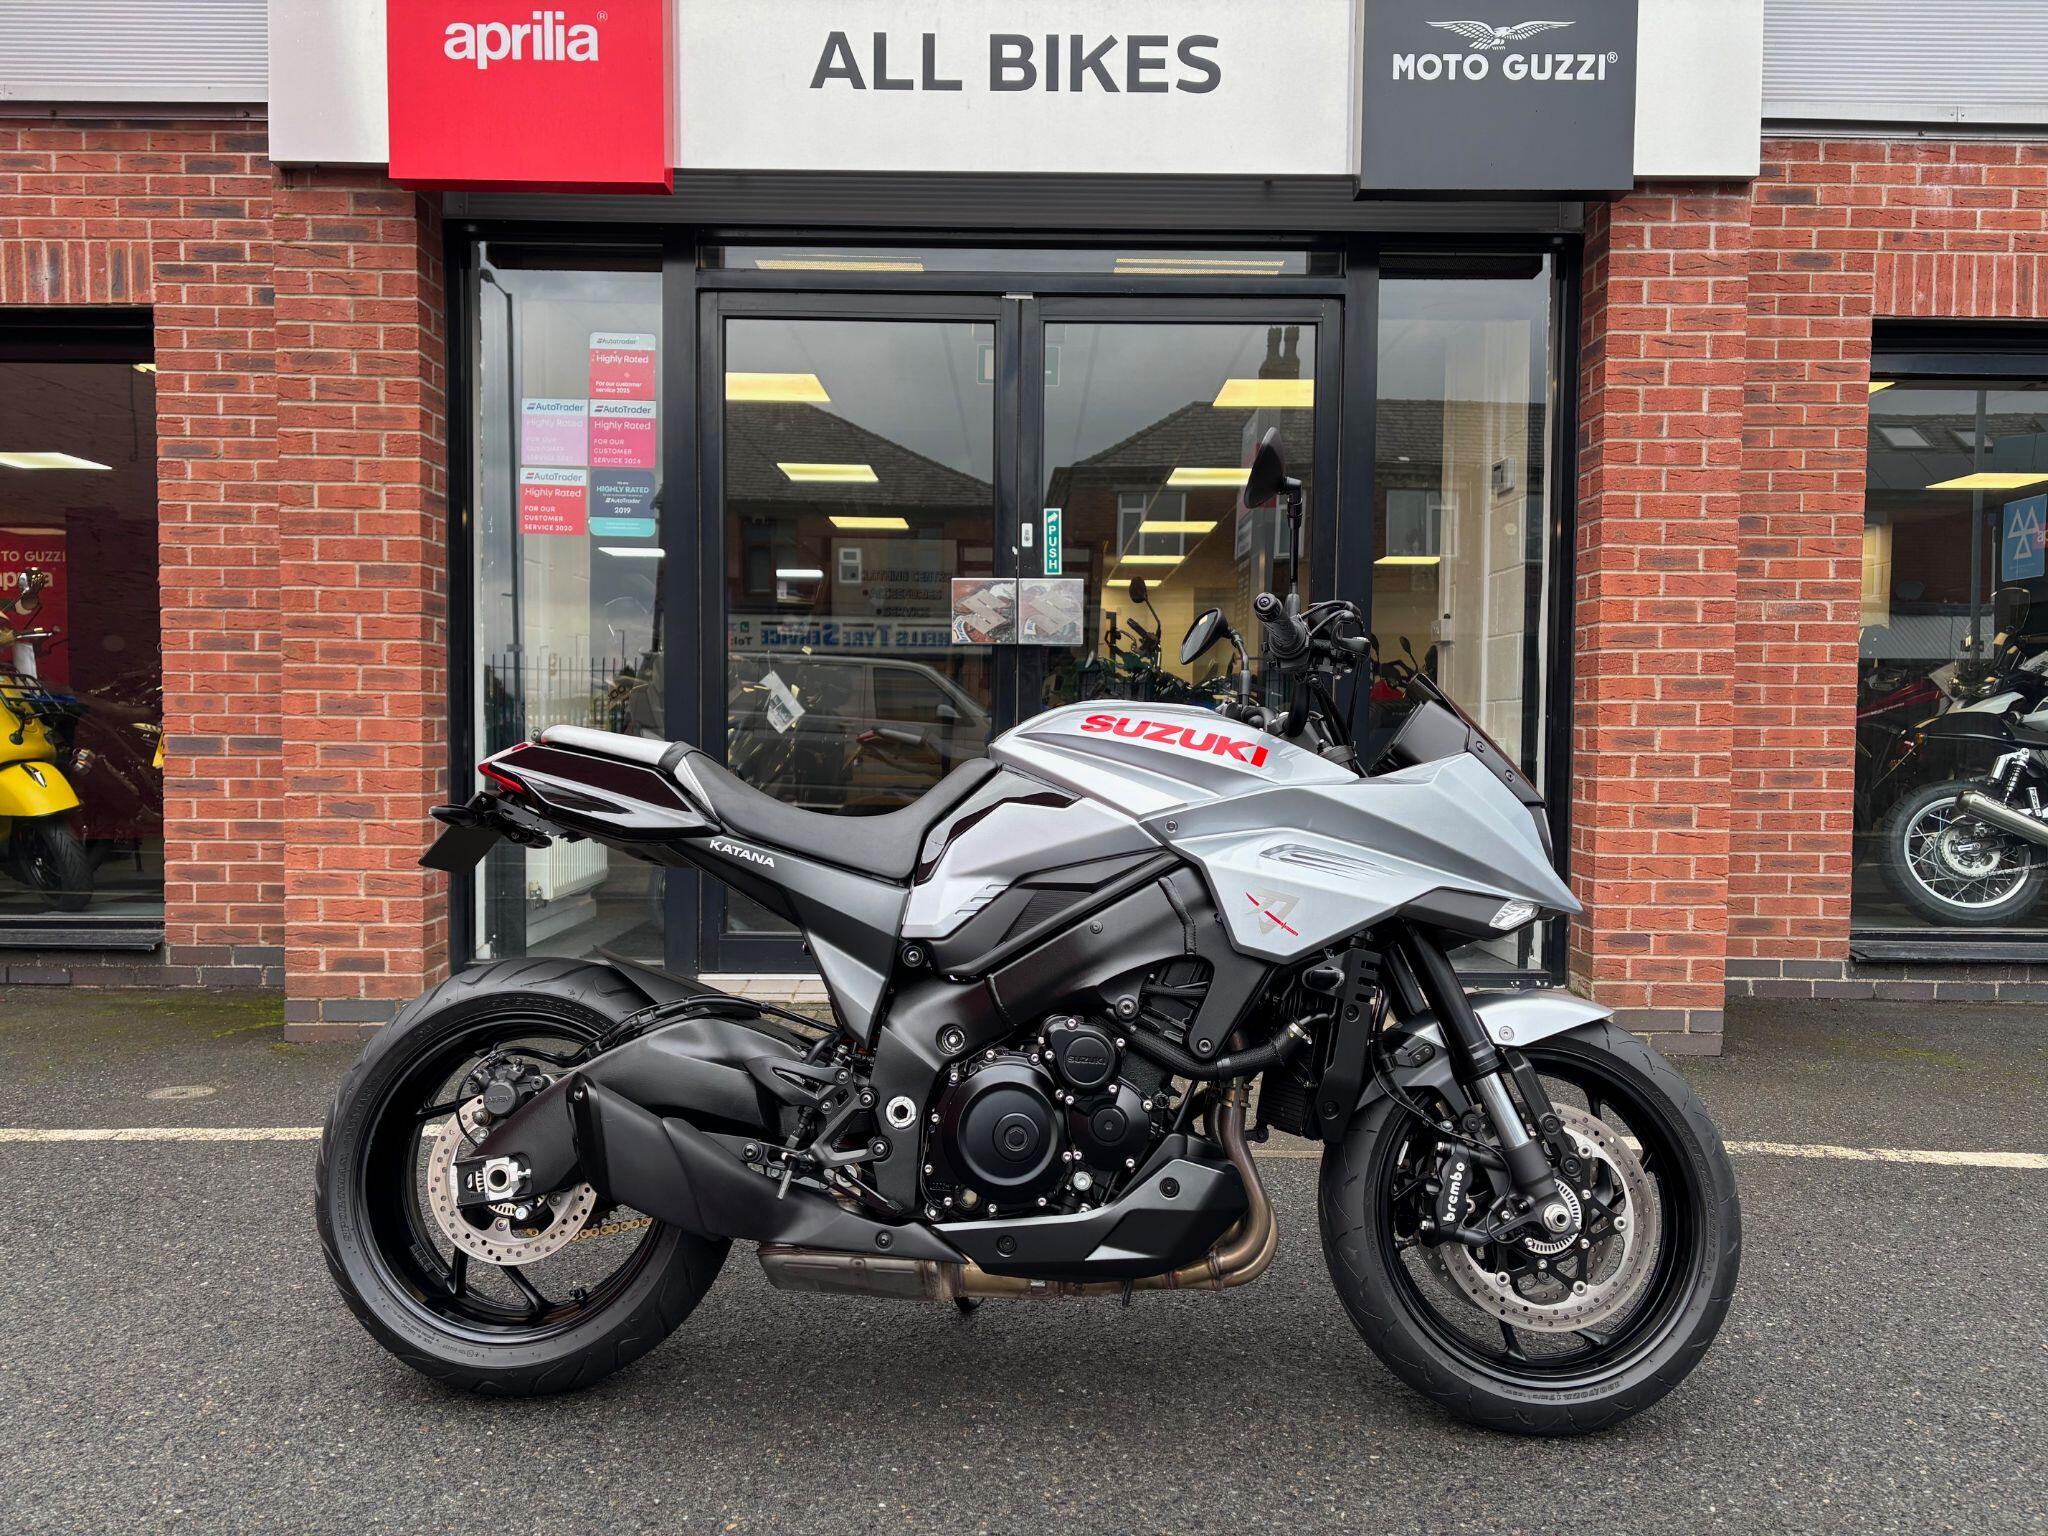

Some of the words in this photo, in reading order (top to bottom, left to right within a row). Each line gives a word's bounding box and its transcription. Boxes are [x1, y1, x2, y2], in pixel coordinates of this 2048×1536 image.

[444, 11, 599, 70] aprilia
[809, 31, 963, 91] ALL
[989, 34, 1222, 94] BIKES
[1392, 53, 1489, 81] MOTO
[1502, 53, 1606, 81] GUZZI
[596, 354, 623, 365] Highly
[624, 355, 649, 364] Rated
[535, 403, 585, 412] AutoTrader
[602, 405, 652, 415] AutoTrader
[594, 419, 623, 431] Highly
[624, 421, 651, 431] Rated
[594, 438, 608, 446] FOR
[594, 447, 632, 455] CUSTOMER
[533, 471, 583, 482] AutoTrader
[525, 488, 554, 499] Highly
[555, 488, 582, 498] Rated
[596, 485, 624, 493] HIGHLY
[625, 486, 650, 494] RATED
[614, 506, 632, 514] 2019
[524, 523, 555, 531] SERVICE
[1048, 525, 1058, 570] PUSH
[1, 551, 20, 561] TO
[25, 551, 66, 562] GUZZI
[1080, 714, 1269, 768] SUZUKI
[709, 839, 775, 868] KATANA
[1442, 1162, 1466, 1222] brembo
